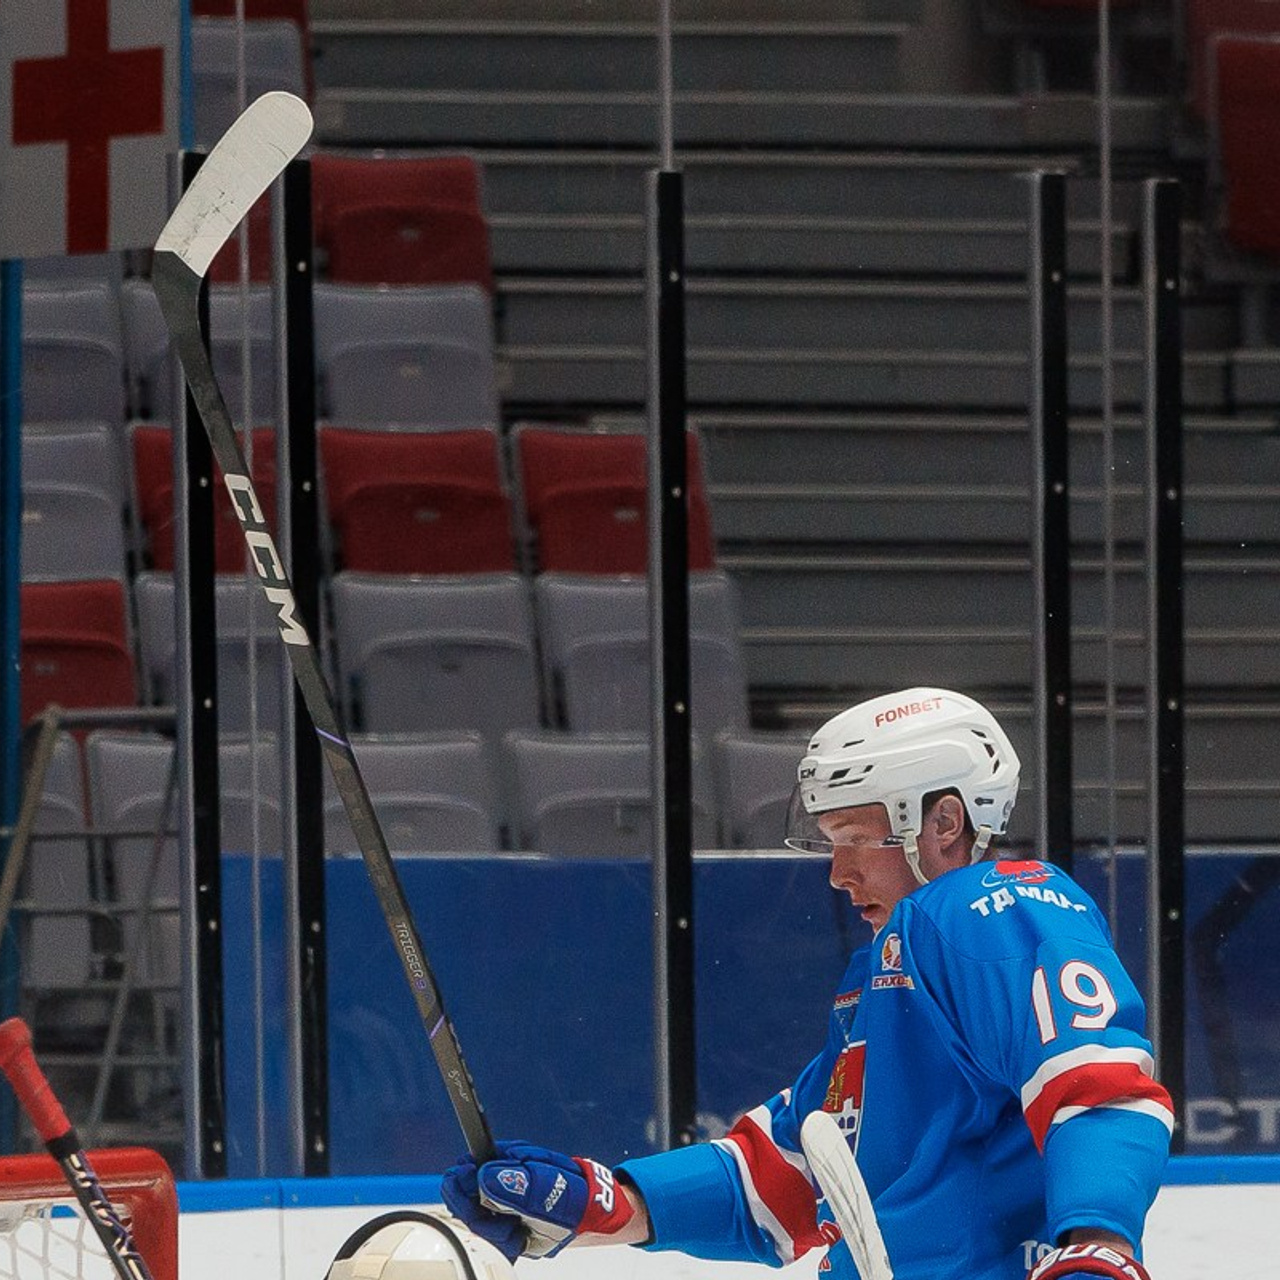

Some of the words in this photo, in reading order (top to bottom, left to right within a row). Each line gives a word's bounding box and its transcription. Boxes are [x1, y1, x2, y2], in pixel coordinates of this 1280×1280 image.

[224, 473, 309, 646] CCM
[875, 698, 942, 727] FONBET
[1031, 959, 1117, 1045] 19
